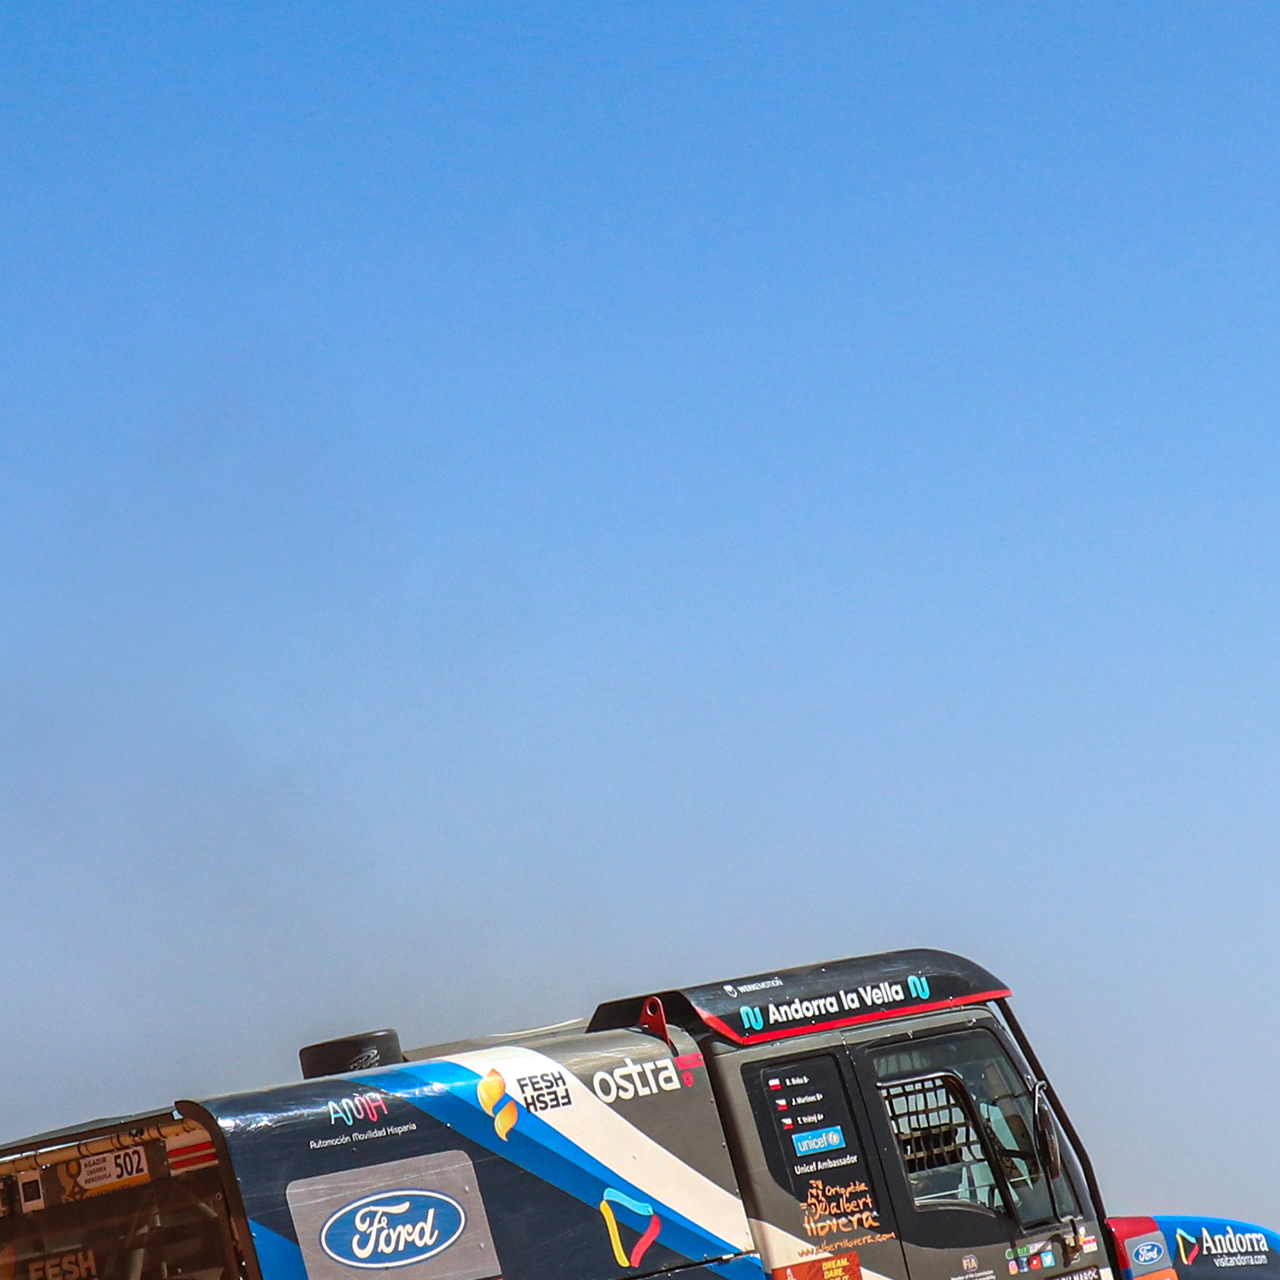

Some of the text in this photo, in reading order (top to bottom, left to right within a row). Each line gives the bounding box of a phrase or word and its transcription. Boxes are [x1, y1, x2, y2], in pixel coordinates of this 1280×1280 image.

[768, 983, 905, 1025] Andorra la Vella
[516, 1070, 567, 1095] FESH
[309, 1121, 417, 1150] Automoción Movilidad Hispania
[797, 1132, 828, 1152] unicef
[114, 1150, 144, 1180] 502
[793, 1154, 858, 1175] Unicef Ambassador
[830, 1194, 873, 1214] albert
[351, 1201, 439, 1259] Ford
[1201, 1226, 1270, 1255] Andorra
[1138, 1244, 1159, 1262] Ford
[1213, 1254, 1268, 1268] visitandorra.com
[822, 1258, 850, 1271] DREAM.
[824, 1267, 845, 1279] DARE.
